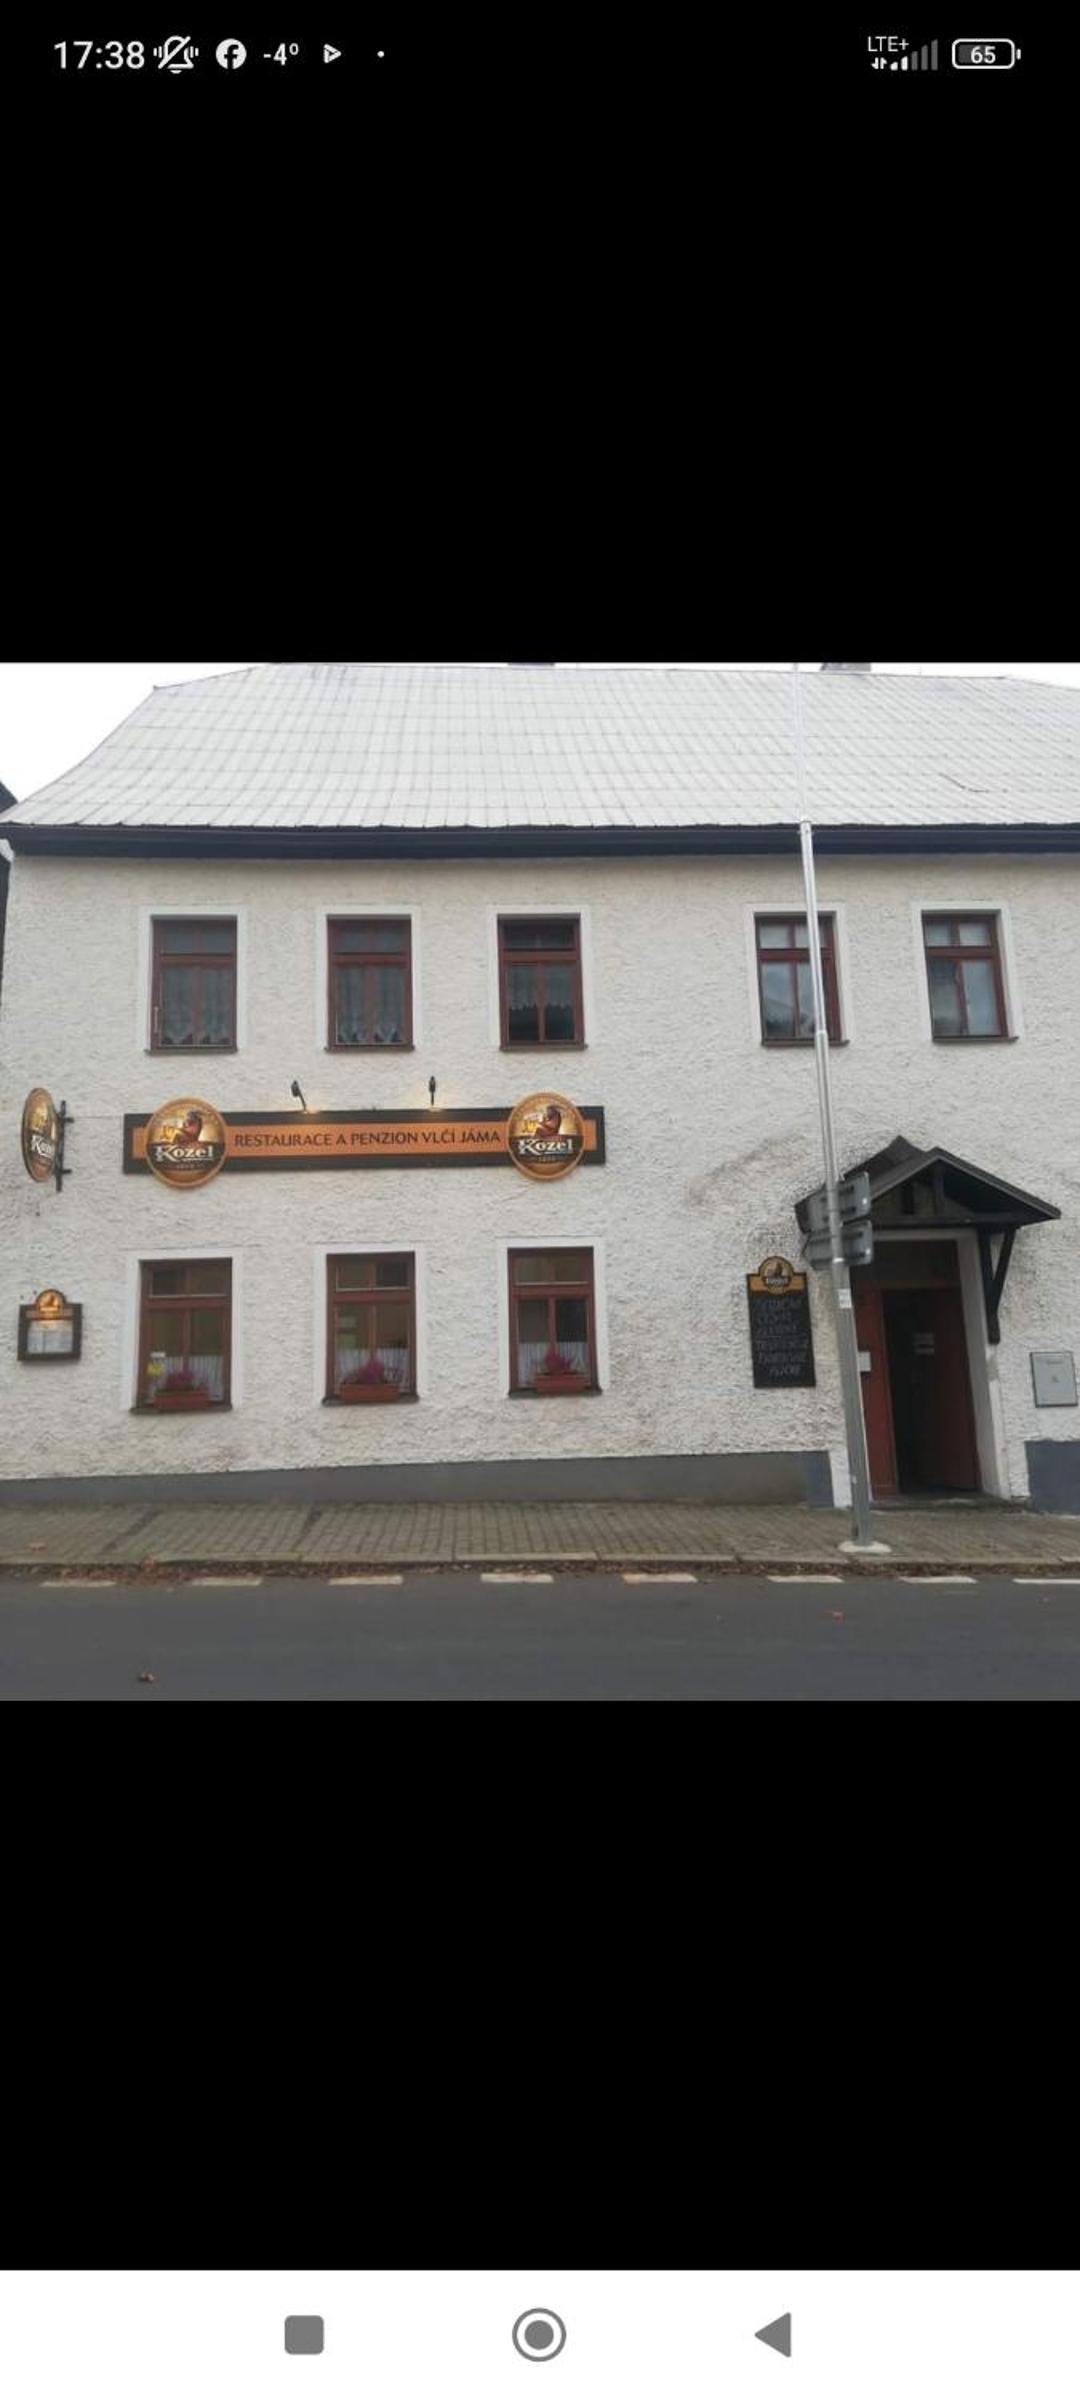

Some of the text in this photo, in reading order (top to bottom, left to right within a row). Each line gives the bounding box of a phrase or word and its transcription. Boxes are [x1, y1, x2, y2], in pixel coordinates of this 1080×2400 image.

[234, 1127, 501, 1148] RESTAURACE A PENZION VLČÍ JÁMA
[154, 1144, 214, 1162] Kozel
[517, 1138, 574, 1156] Kozel
